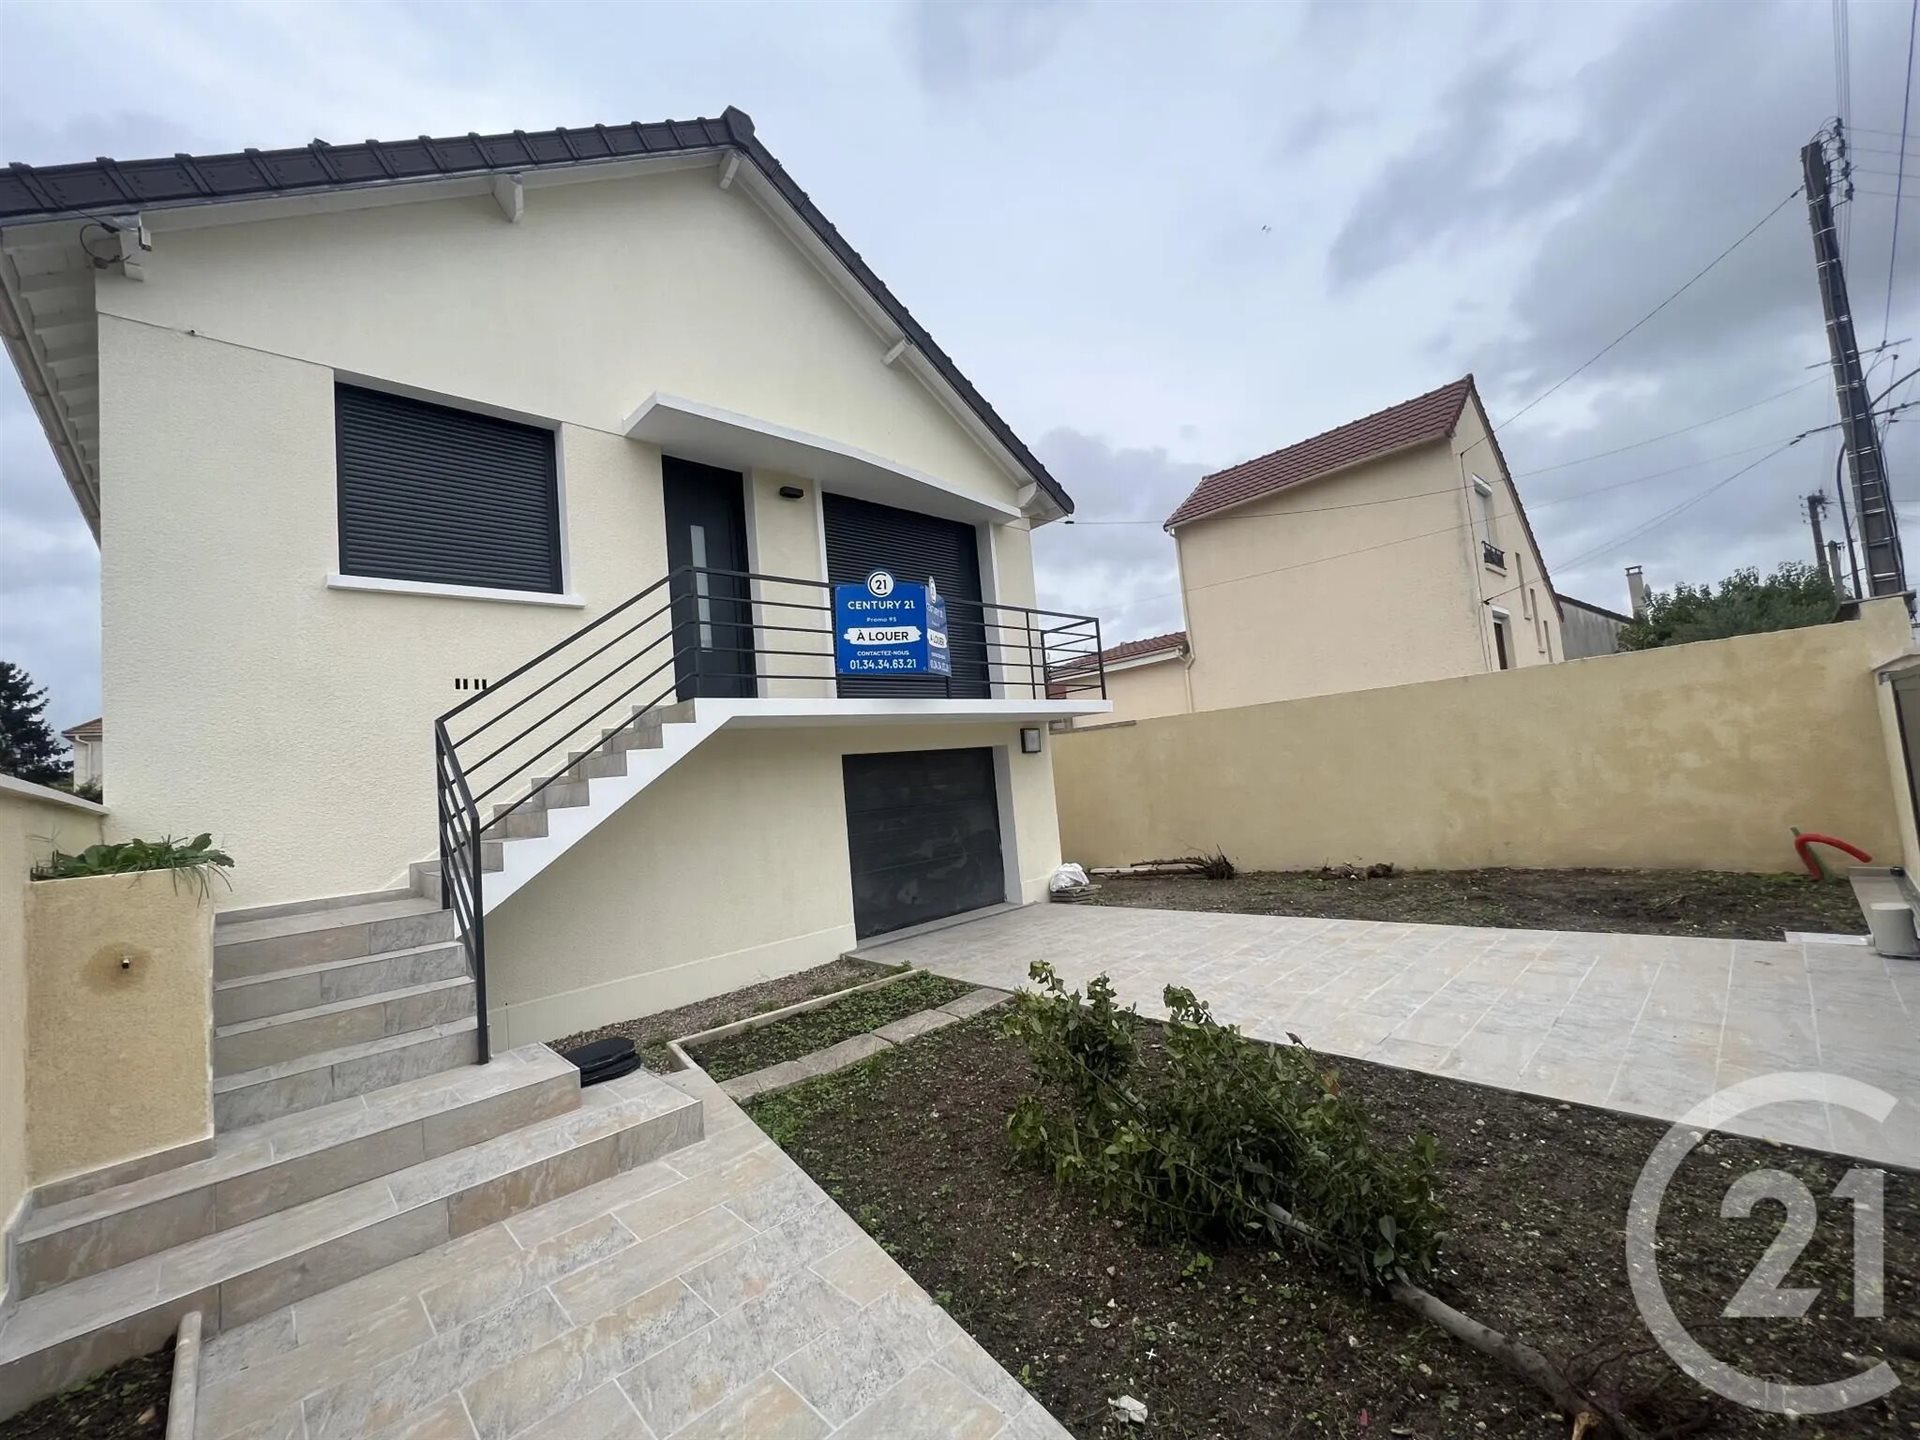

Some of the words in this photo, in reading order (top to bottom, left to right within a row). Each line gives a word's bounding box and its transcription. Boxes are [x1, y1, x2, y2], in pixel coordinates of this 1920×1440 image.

[875, 580, 886, 590] 21
[847, 600, 901, 610] CENTURY
[904, 600, 915, 609] 21
[857, 629, 866, 641] À
[868, 631, 909, 641] LOUER
[849, 658, 917, 670] 01.34.34.63.21
